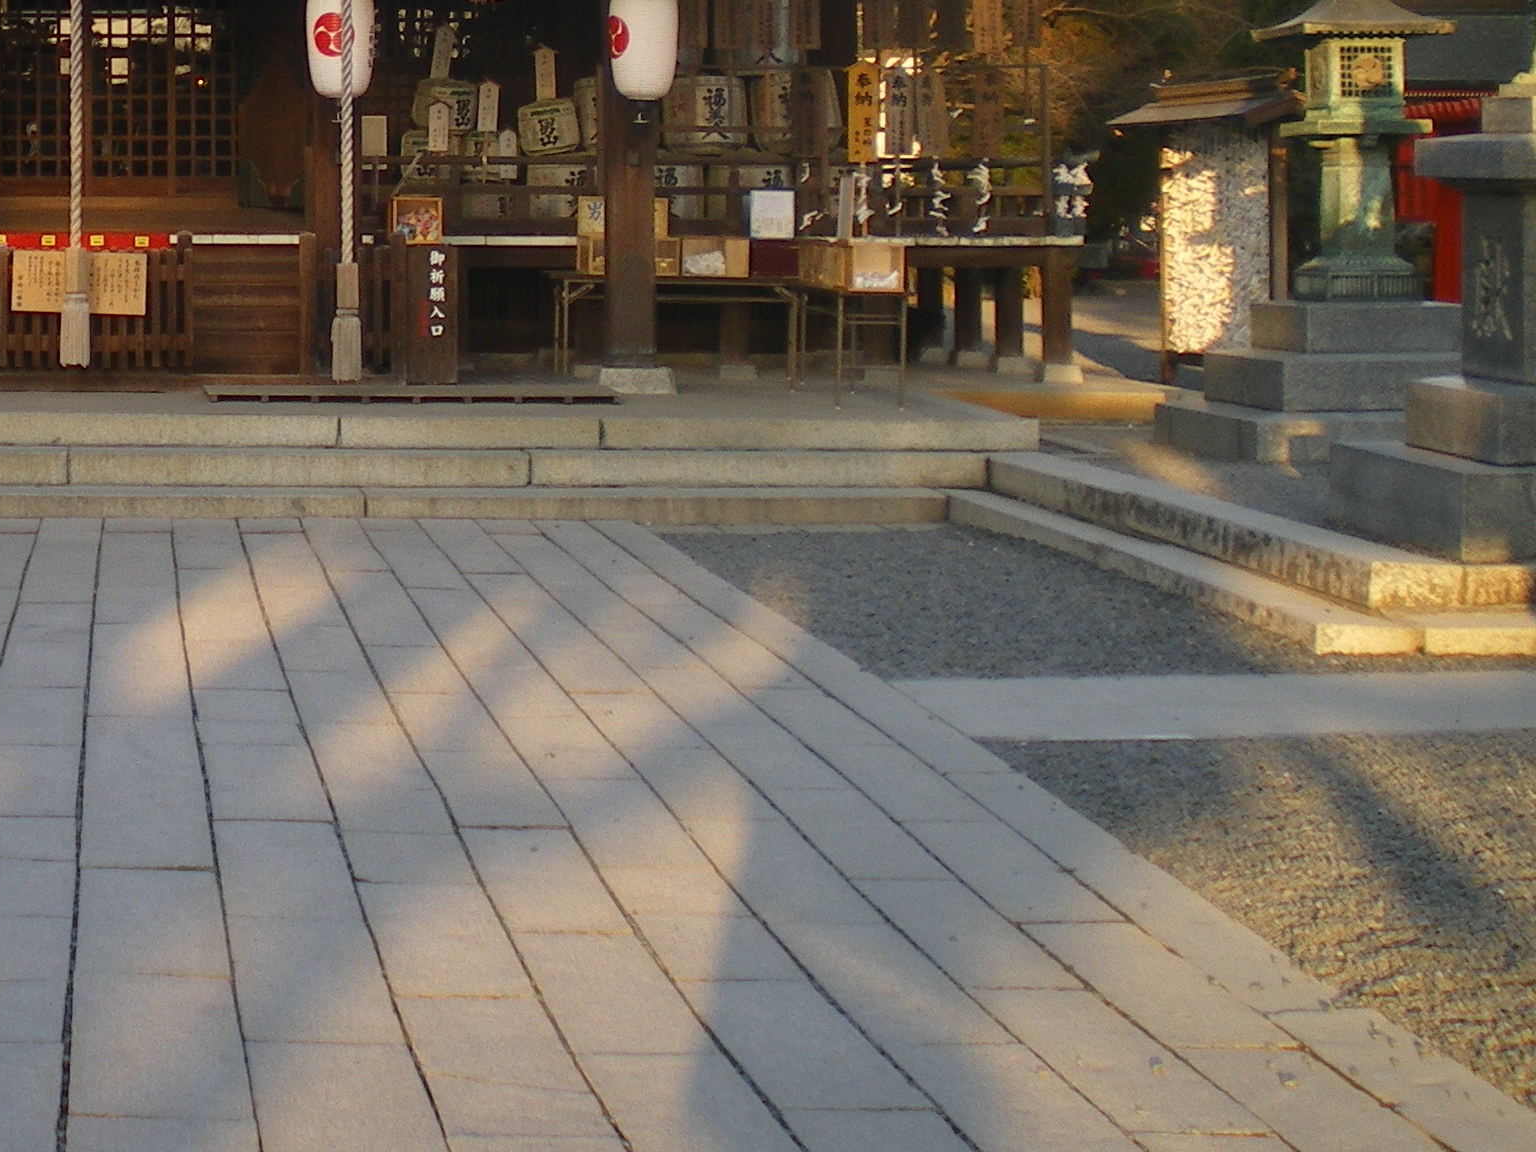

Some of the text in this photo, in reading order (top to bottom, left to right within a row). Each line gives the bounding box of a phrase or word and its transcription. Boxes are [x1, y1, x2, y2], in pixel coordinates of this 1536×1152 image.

[854, 73, 873, 108] 奉納
[891, 75, 908, 108] 奉納
[454, 99, 471, 128] 男山
[536, 117, 560, 147] 男山
[428, 250, 446, 337] 御祈願入口
